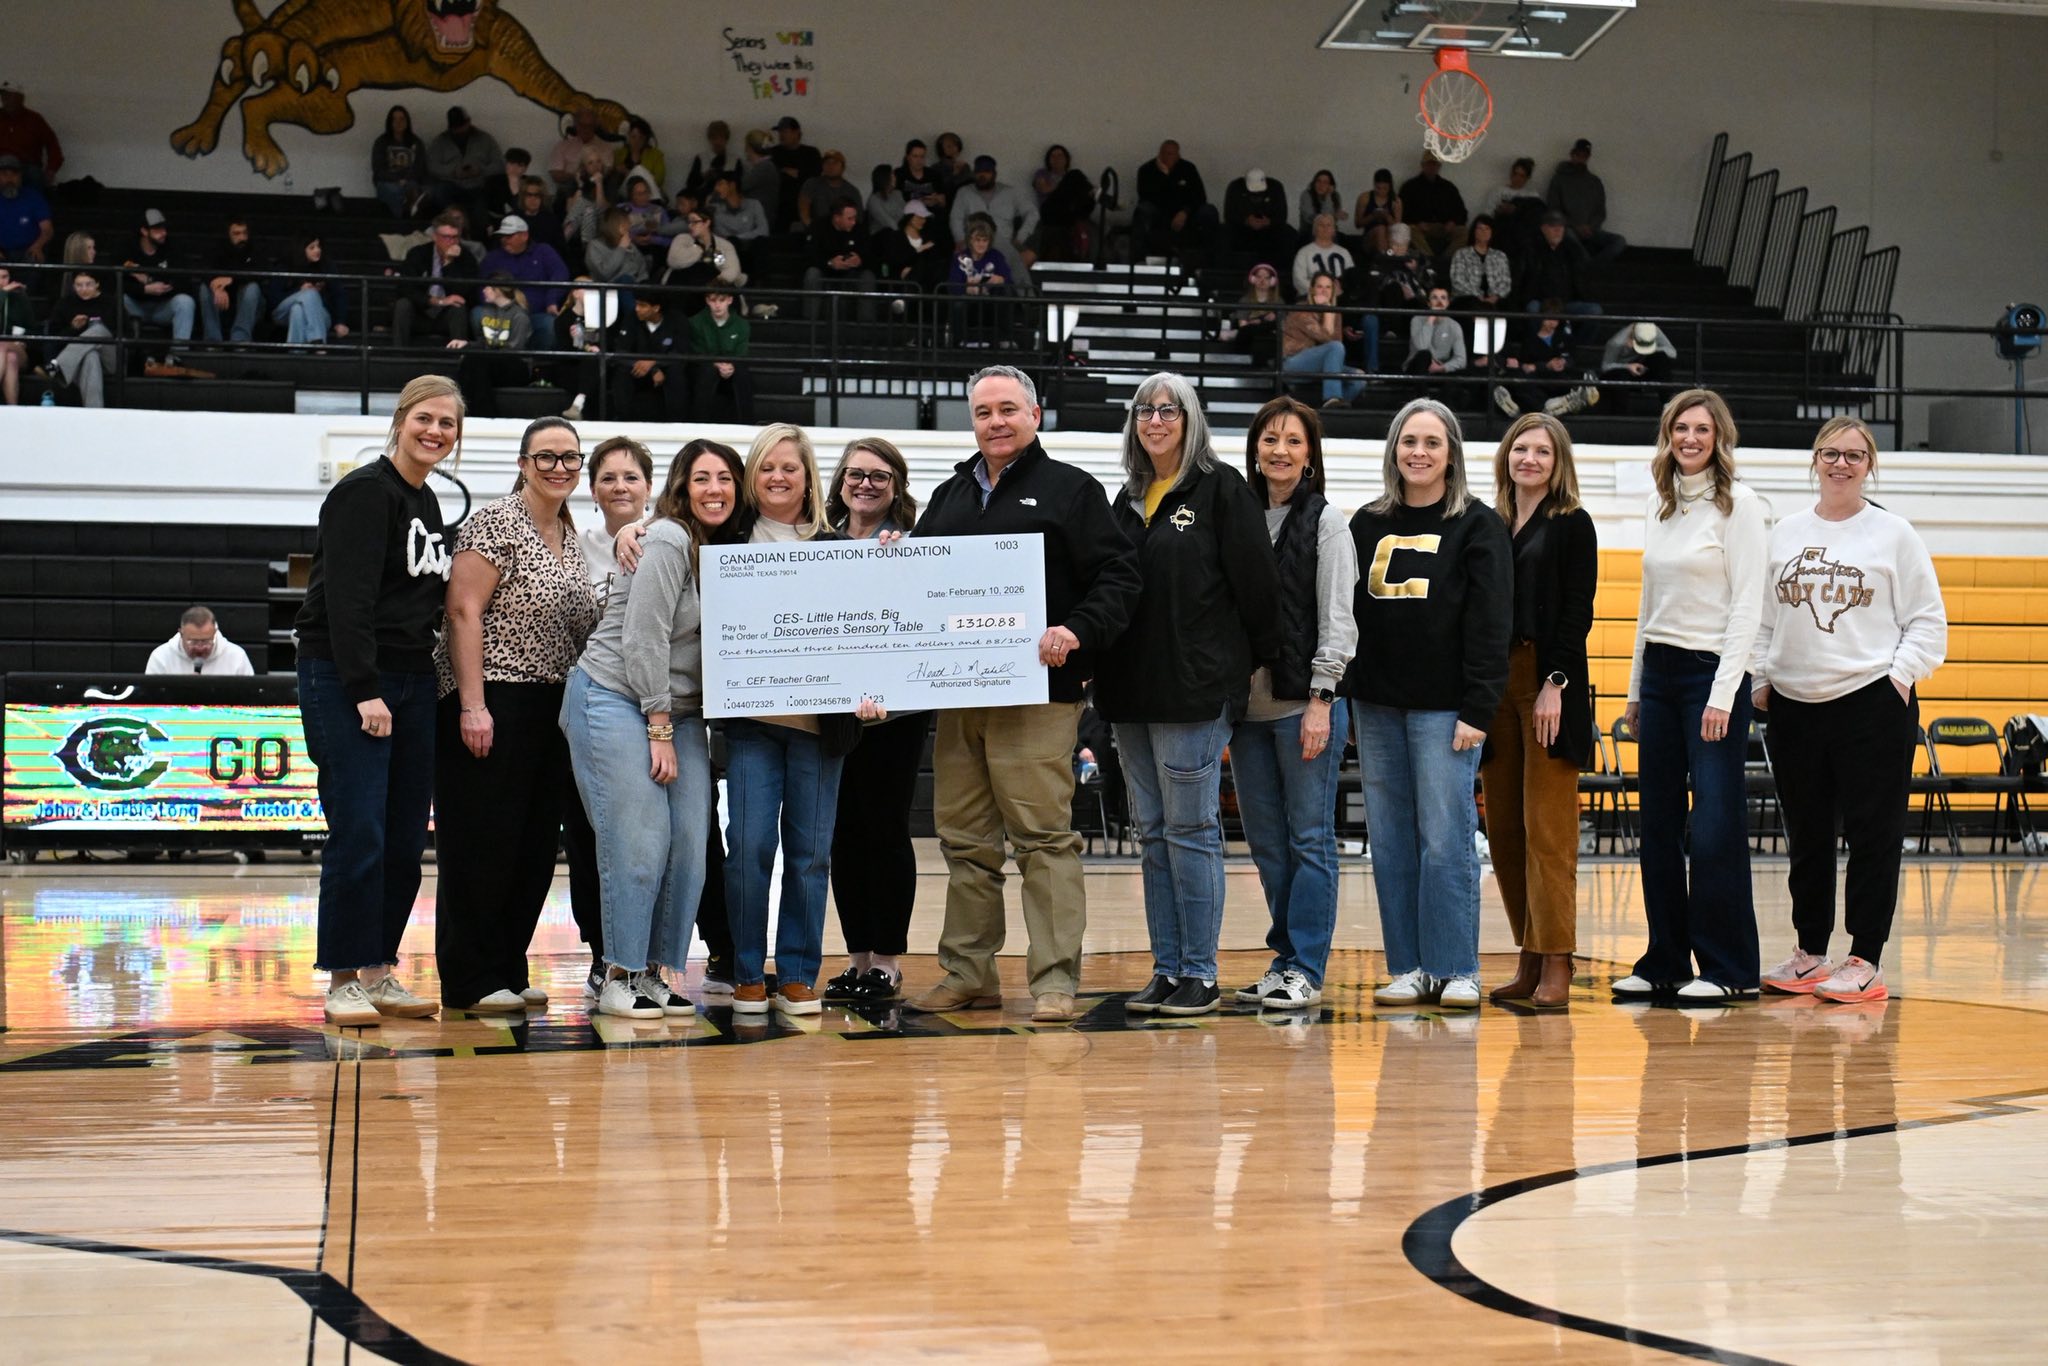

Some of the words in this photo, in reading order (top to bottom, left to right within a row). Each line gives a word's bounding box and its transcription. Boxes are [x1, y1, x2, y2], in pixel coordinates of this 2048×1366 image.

[1312, 252, 1345, 278] 10
[994, 540, 1019, 550] 1003
[720, 552, 786, 565] CANADIAN
[789, 549, 863, 562] EDUCATION
[867, 545, 951, 558] FOUNDATION
[1368, 533, 1441, 599] C
[927, 590, 948, 598] Date:
[950, 588, 986, 597] February
[989, 587, 1002, 596] 10,
[1004, 586, 1025, 594] 2026
[1775, 582, 1816, 604] LADY
[1820, 583, 1876, 608] CATS
[773, 613, 804, 624] CES-
[807, 612, 834, 623] Little
[881, 609, 900, 621] Big
[940, 624, 946, 632] $
[956, 617, 1016, 629] 1310.88
[722, 624, 737, 632] Pay
[736, 632, 758, 640] Order
[760, 632, 768, 640] of
[773, 625, 840, 638] Discoveries
[843, 623, 889, 636] Sensory
[894, 621, 924, 632] Table
[745, 646, 800, 655] thousand
[837, 641, 888, 650] hundred
[914, 638, 954, 648] dollars
[958, 638, 981, 646] and
[746, 676, 766, 686] CEF
[769, 676, 803, 684] Teacher
[805, 674, 830, 683] Grant
[930, 680, 972, 688] Authorized
[974, 679, 1011, 688] Signature
[209, 737, 289, 780] GO
[36, 802, 76, 817] John
[159, 802, 198, 822] Long
[301, 802, 312, 816] &
